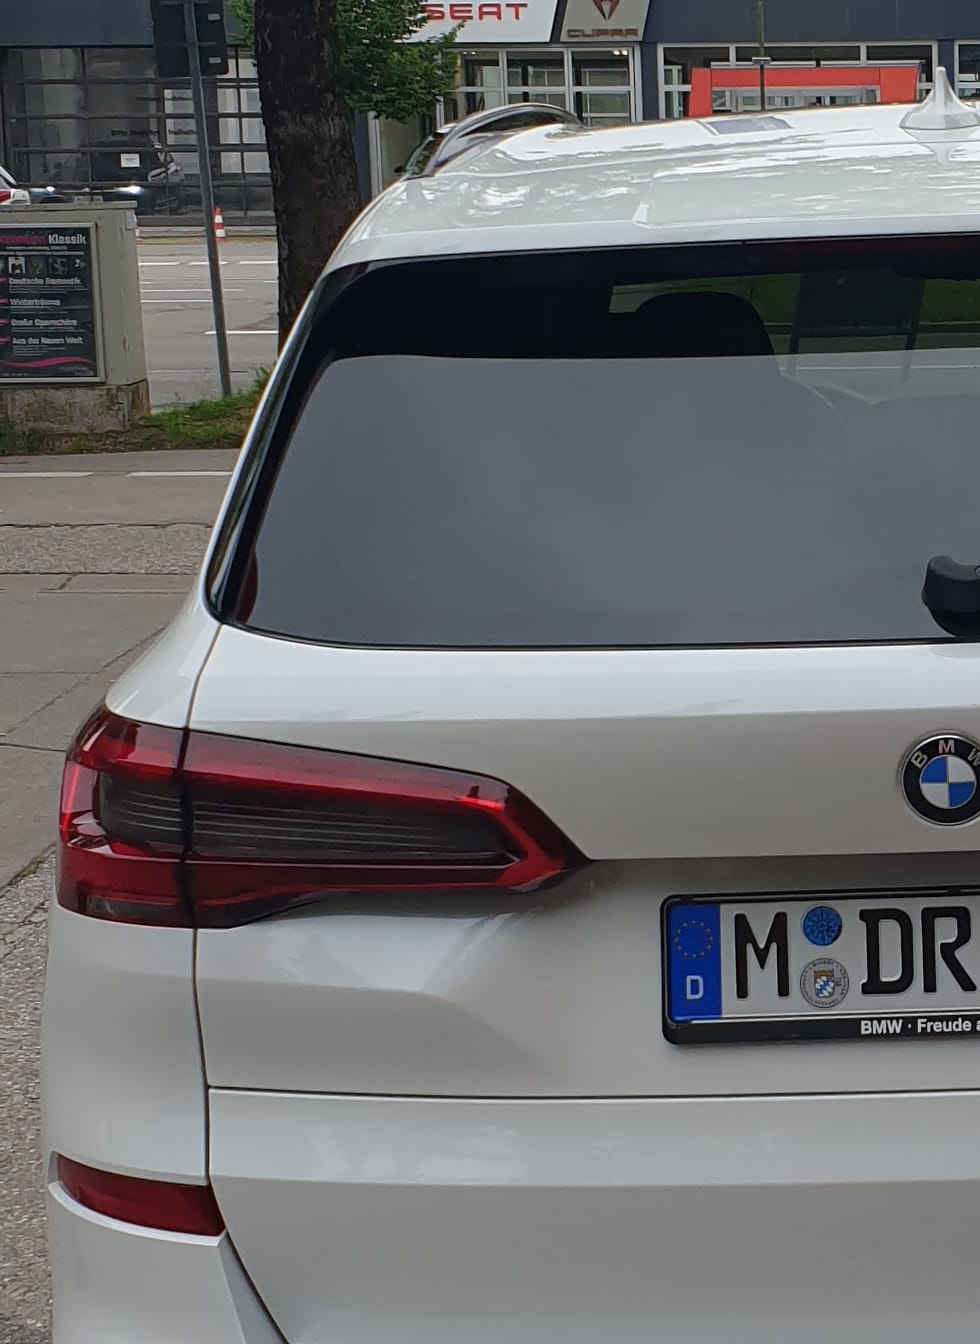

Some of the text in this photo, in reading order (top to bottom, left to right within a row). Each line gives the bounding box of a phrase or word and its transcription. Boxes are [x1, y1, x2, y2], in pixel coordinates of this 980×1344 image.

[421, 3, 528, 21] SEAT
[567, 28, 639, 38] CUPRA
[48, 234, 87, 245] Klassik
[734, 911, 791, 999] M
[858, 906, 978, 995] DR
[685, 974, 705, 1000] D
[860, 1019, 903, 1035] BMW
[916, 1017, 973, 1034] Freude
